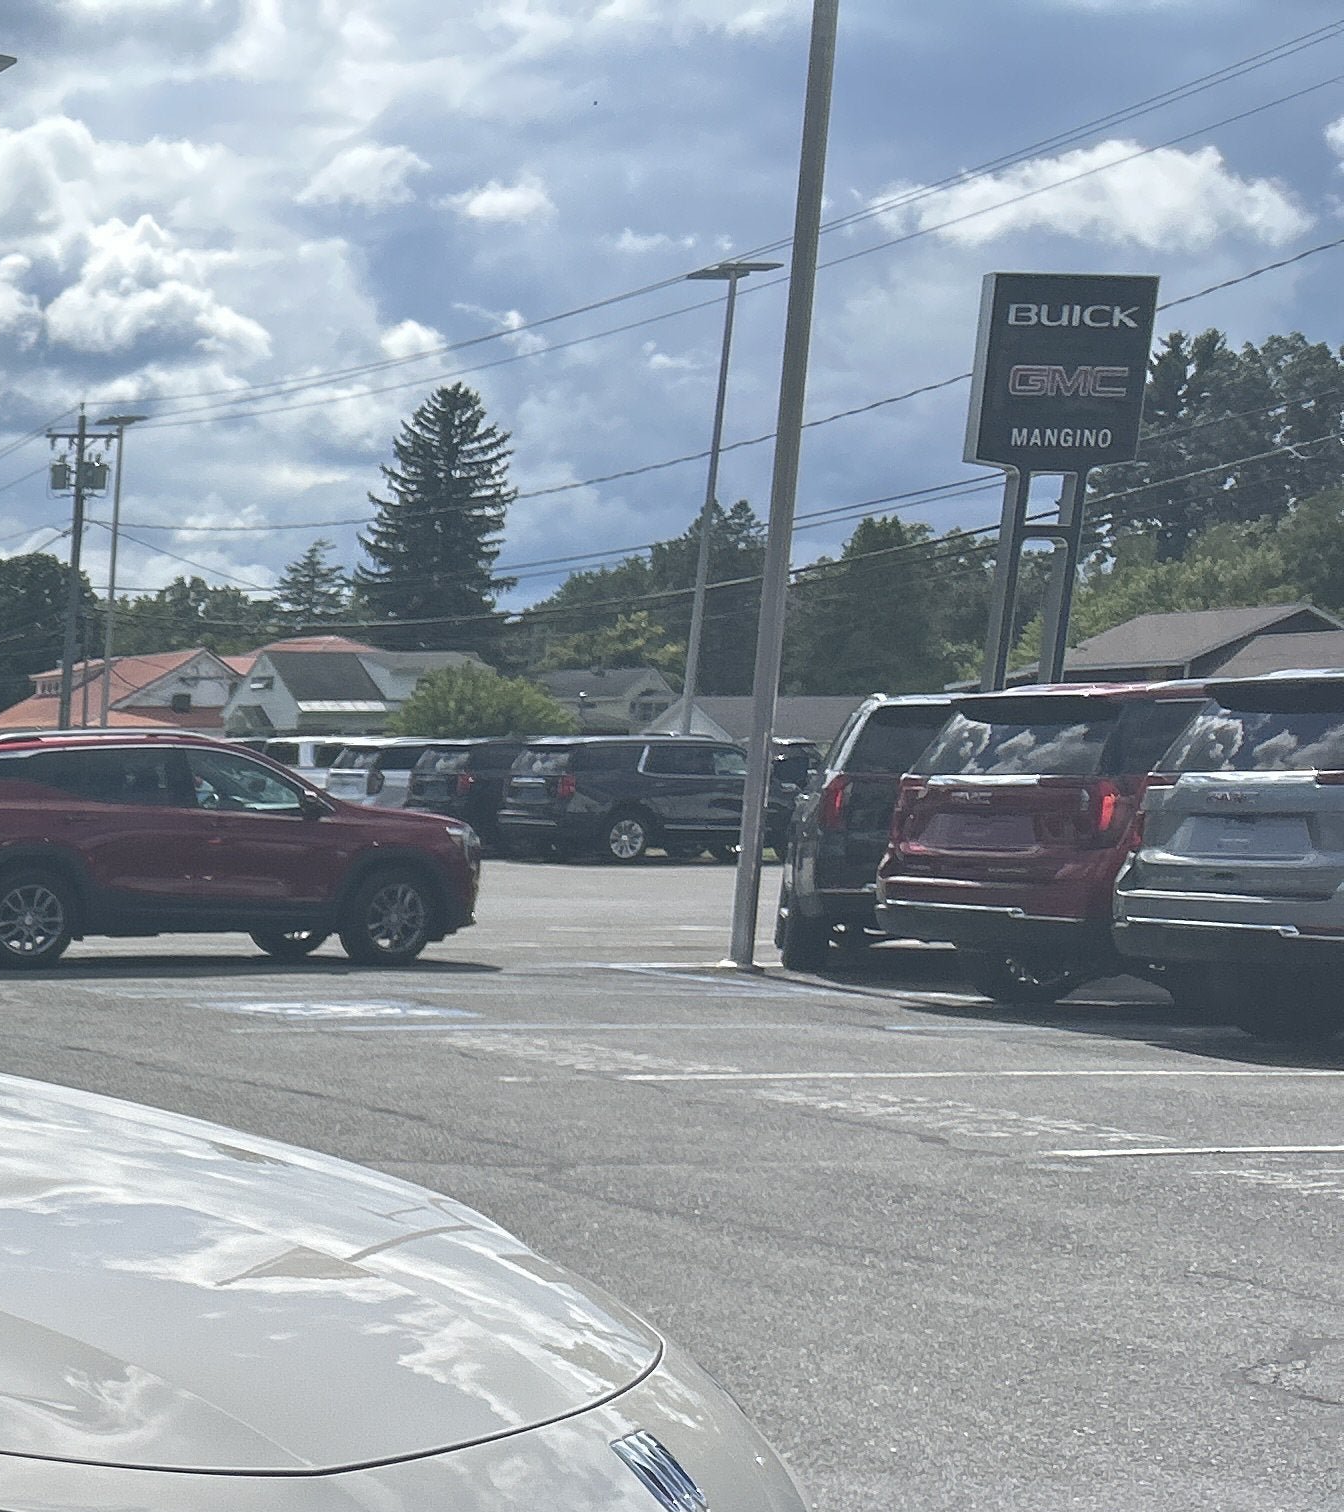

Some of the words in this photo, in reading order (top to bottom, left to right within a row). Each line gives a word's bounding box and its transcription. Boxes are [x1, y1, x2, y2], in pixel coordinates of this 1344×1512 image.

[1007, 303, 1140, 328] BUICK
[1009, 365, 1129, 397] GMC
[1011, 428, 1112, 448] MANGINO
